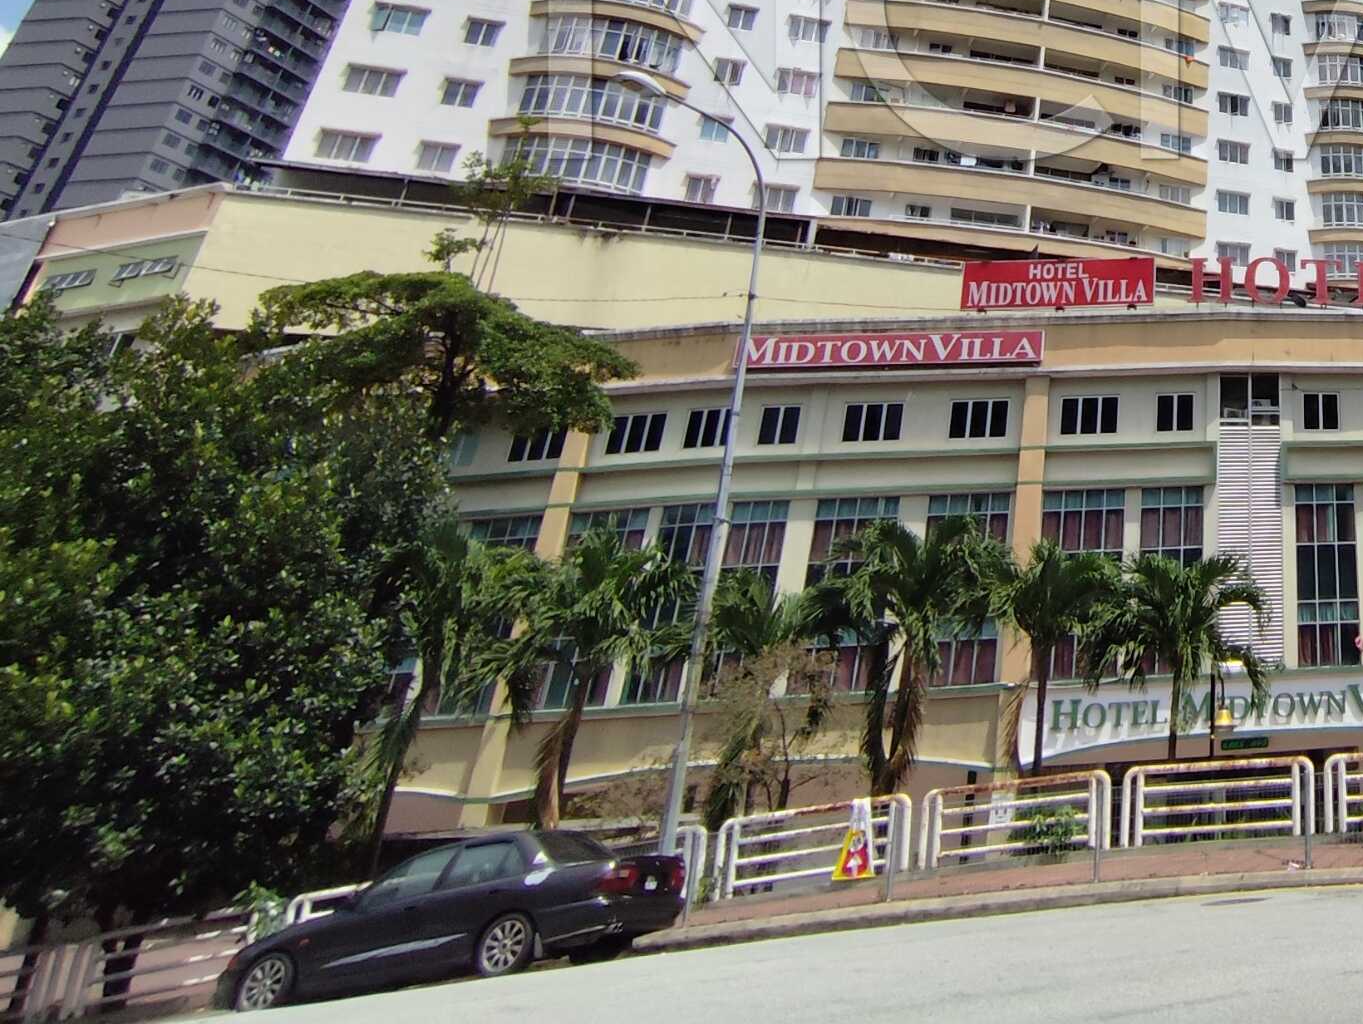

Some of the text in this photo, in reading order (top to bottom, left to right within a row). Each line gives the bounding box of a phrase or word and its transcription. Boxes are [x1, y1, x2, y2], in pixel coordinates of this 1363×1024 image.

[1029, 263, 1089, 279] HOTEL
[966, 278, 1148, 307] MIDTOWN VILLA
[1050, 699, 1168, 731] HOTEL
